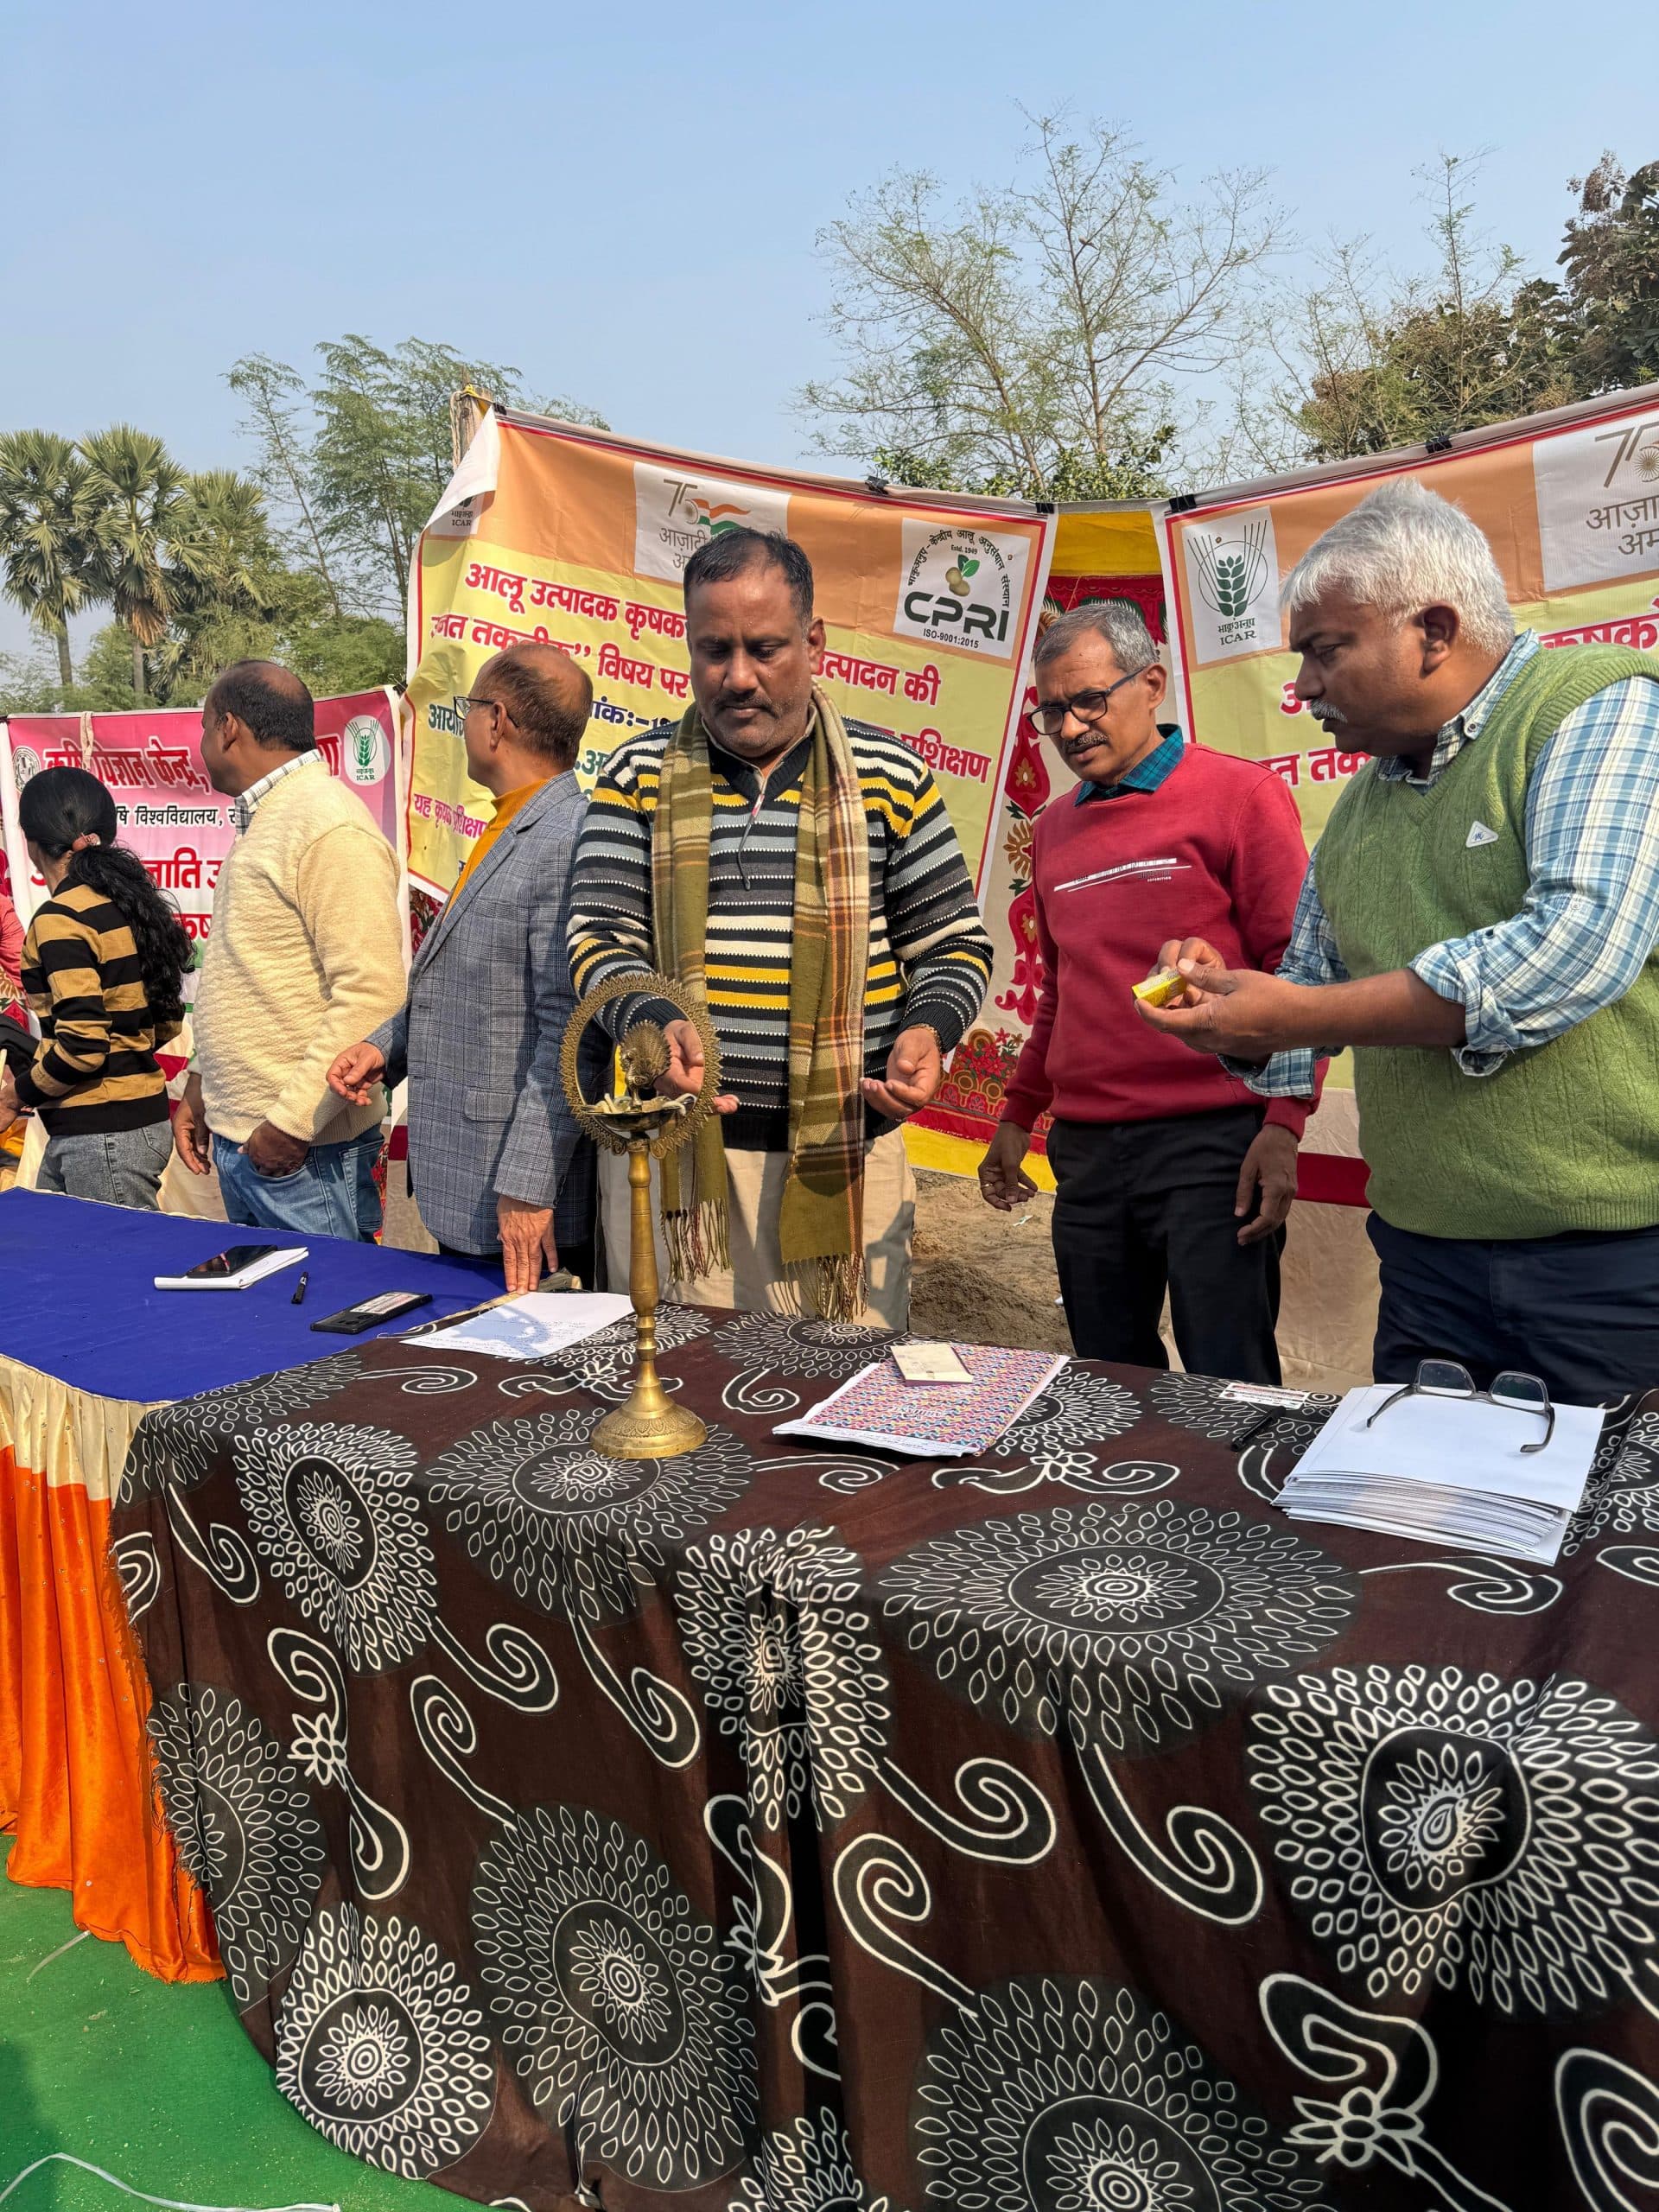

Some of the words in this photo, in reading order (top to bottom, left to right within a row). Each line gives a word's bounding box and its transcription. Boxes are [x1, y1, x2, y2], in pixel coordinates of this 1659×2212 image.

[1586, 496, 1659, 529] आज़ा
[465, 563, 527, 614] आलू
[530, 579, 620, 621] उत्पादक
[625, 601, 689, 640] कृषक
[904, 591, 1009, 642] CPRI
[923, 628, 979, 649] ISO-9001:2015
[1219, 630, 1256, 645] ICAR
[598, 643, 655, 689] विषय
[660, 668, 690, 698] पर
[904, 664, 941, 705] की
